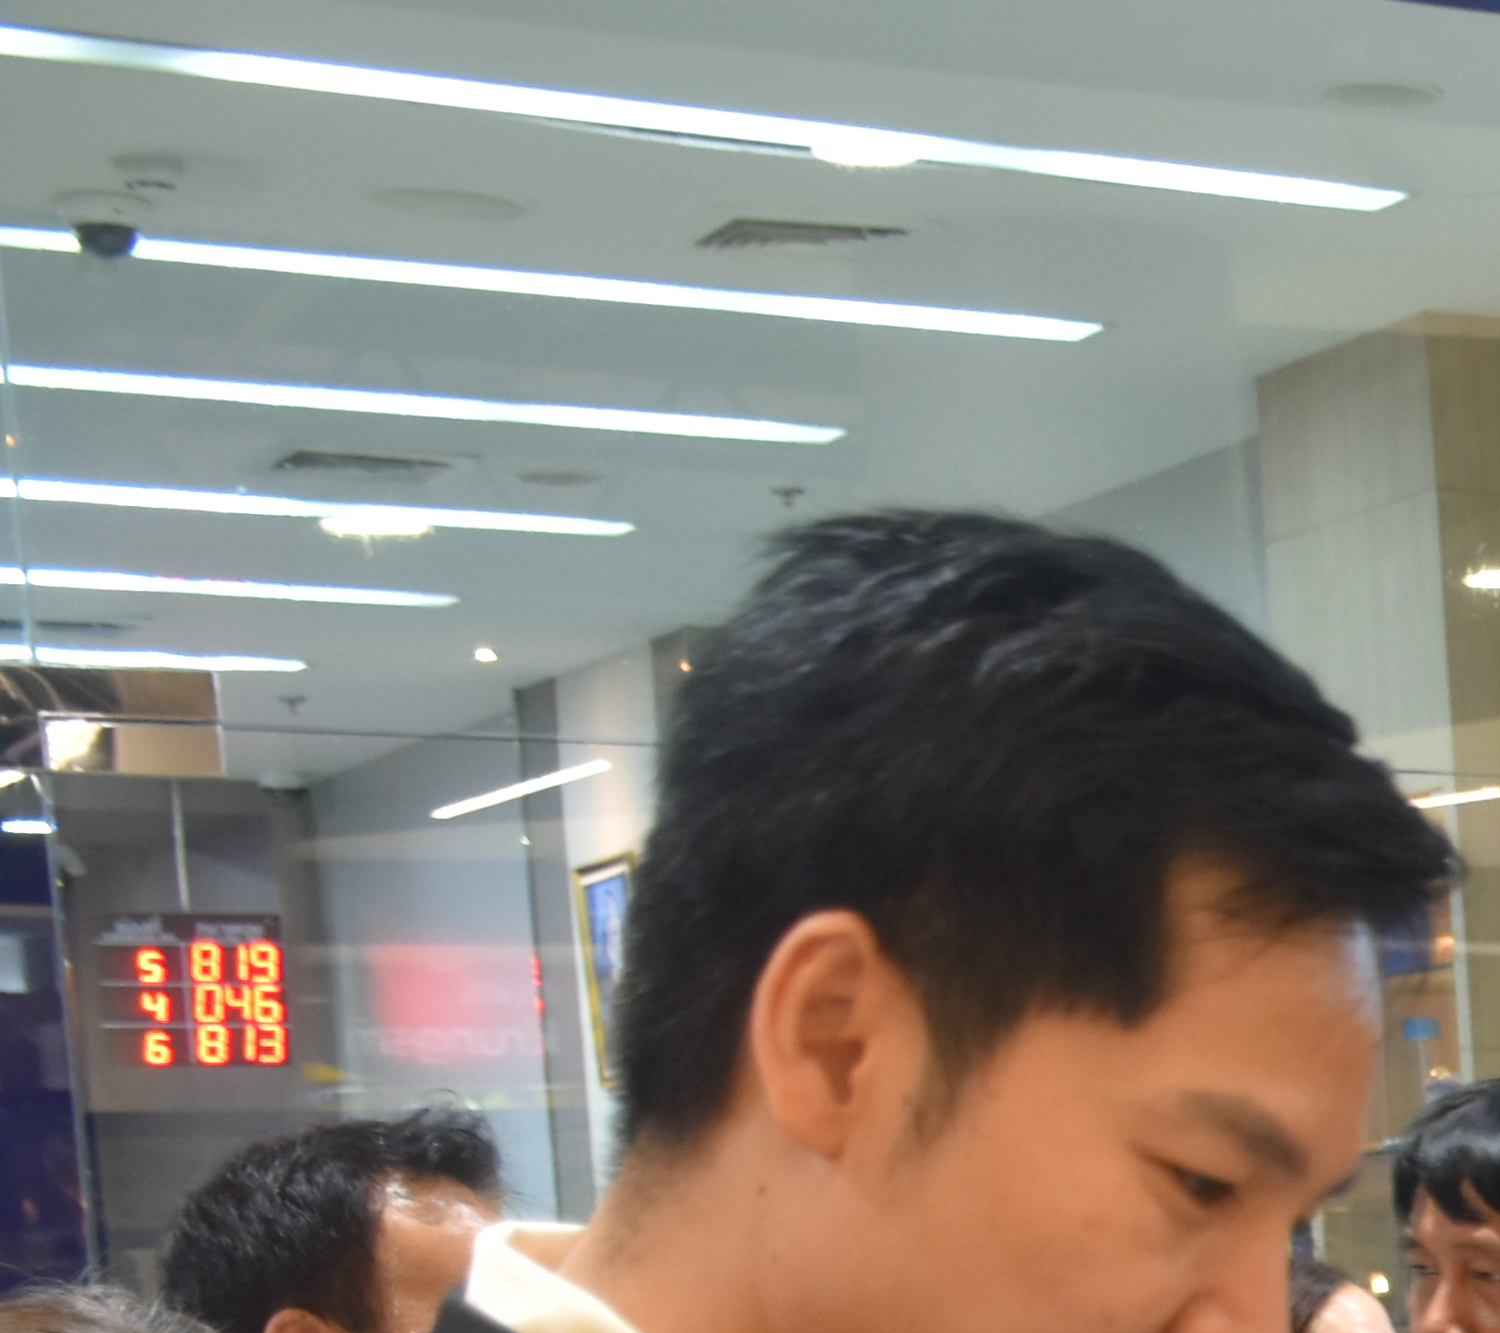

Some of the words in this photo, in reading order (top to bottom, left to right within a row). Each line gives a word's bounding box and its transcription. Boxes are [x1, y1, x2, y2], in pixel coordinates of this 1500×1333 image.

[136, 947, 168, 985] 5
[189, 938, 283, 984] 819
[139, 990, 173, 1024] 4
[193, 983, 286, 1023] 046
[142, 1028, 175, 1067] 6
[195, 1023, 289, 1066] 813
